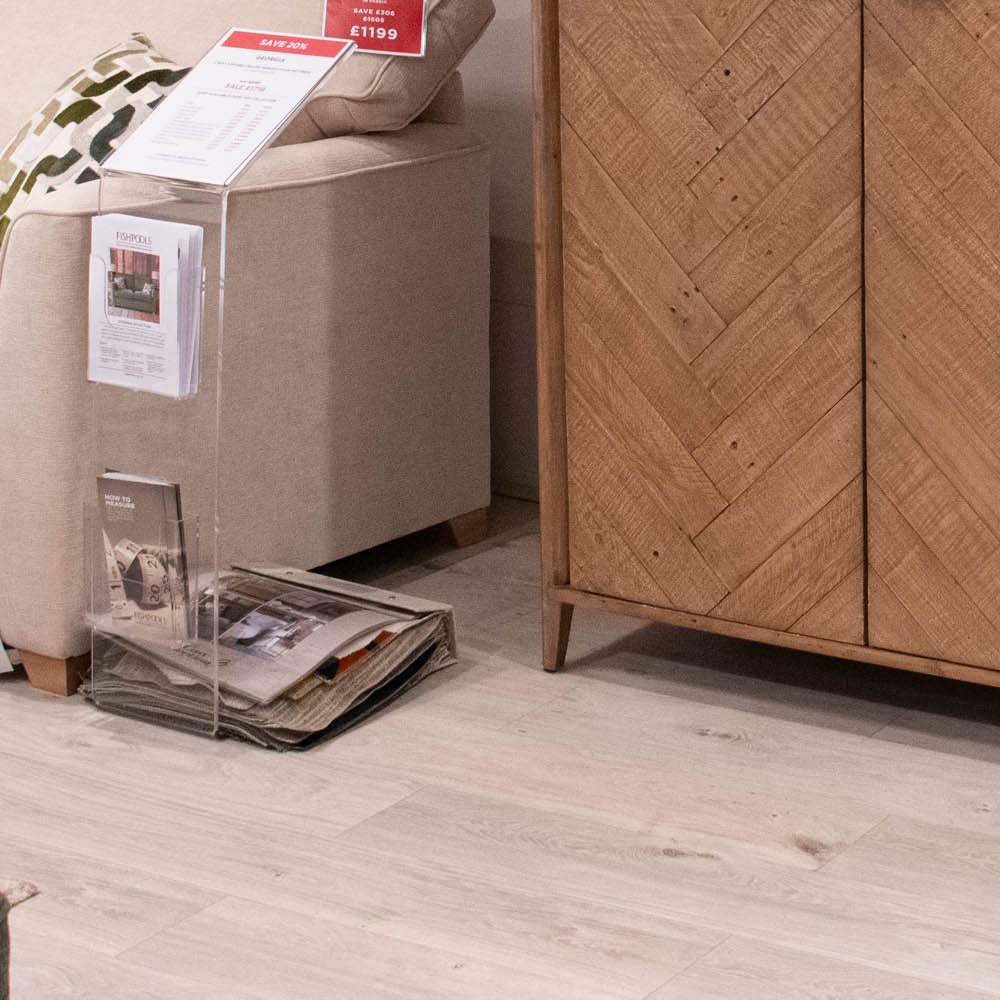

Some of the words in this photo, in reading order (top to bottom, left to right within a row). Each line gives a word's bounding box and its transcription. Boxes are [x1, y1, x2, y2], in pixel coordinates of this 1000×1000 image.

[353, 7, 374, 15] SAVE
[350, 25, 398, 40] £1199
[259, 38, 286, 48] SAVE
[286, 41, 309, 50] 20%
[104, 494, 120, 502] HOW
